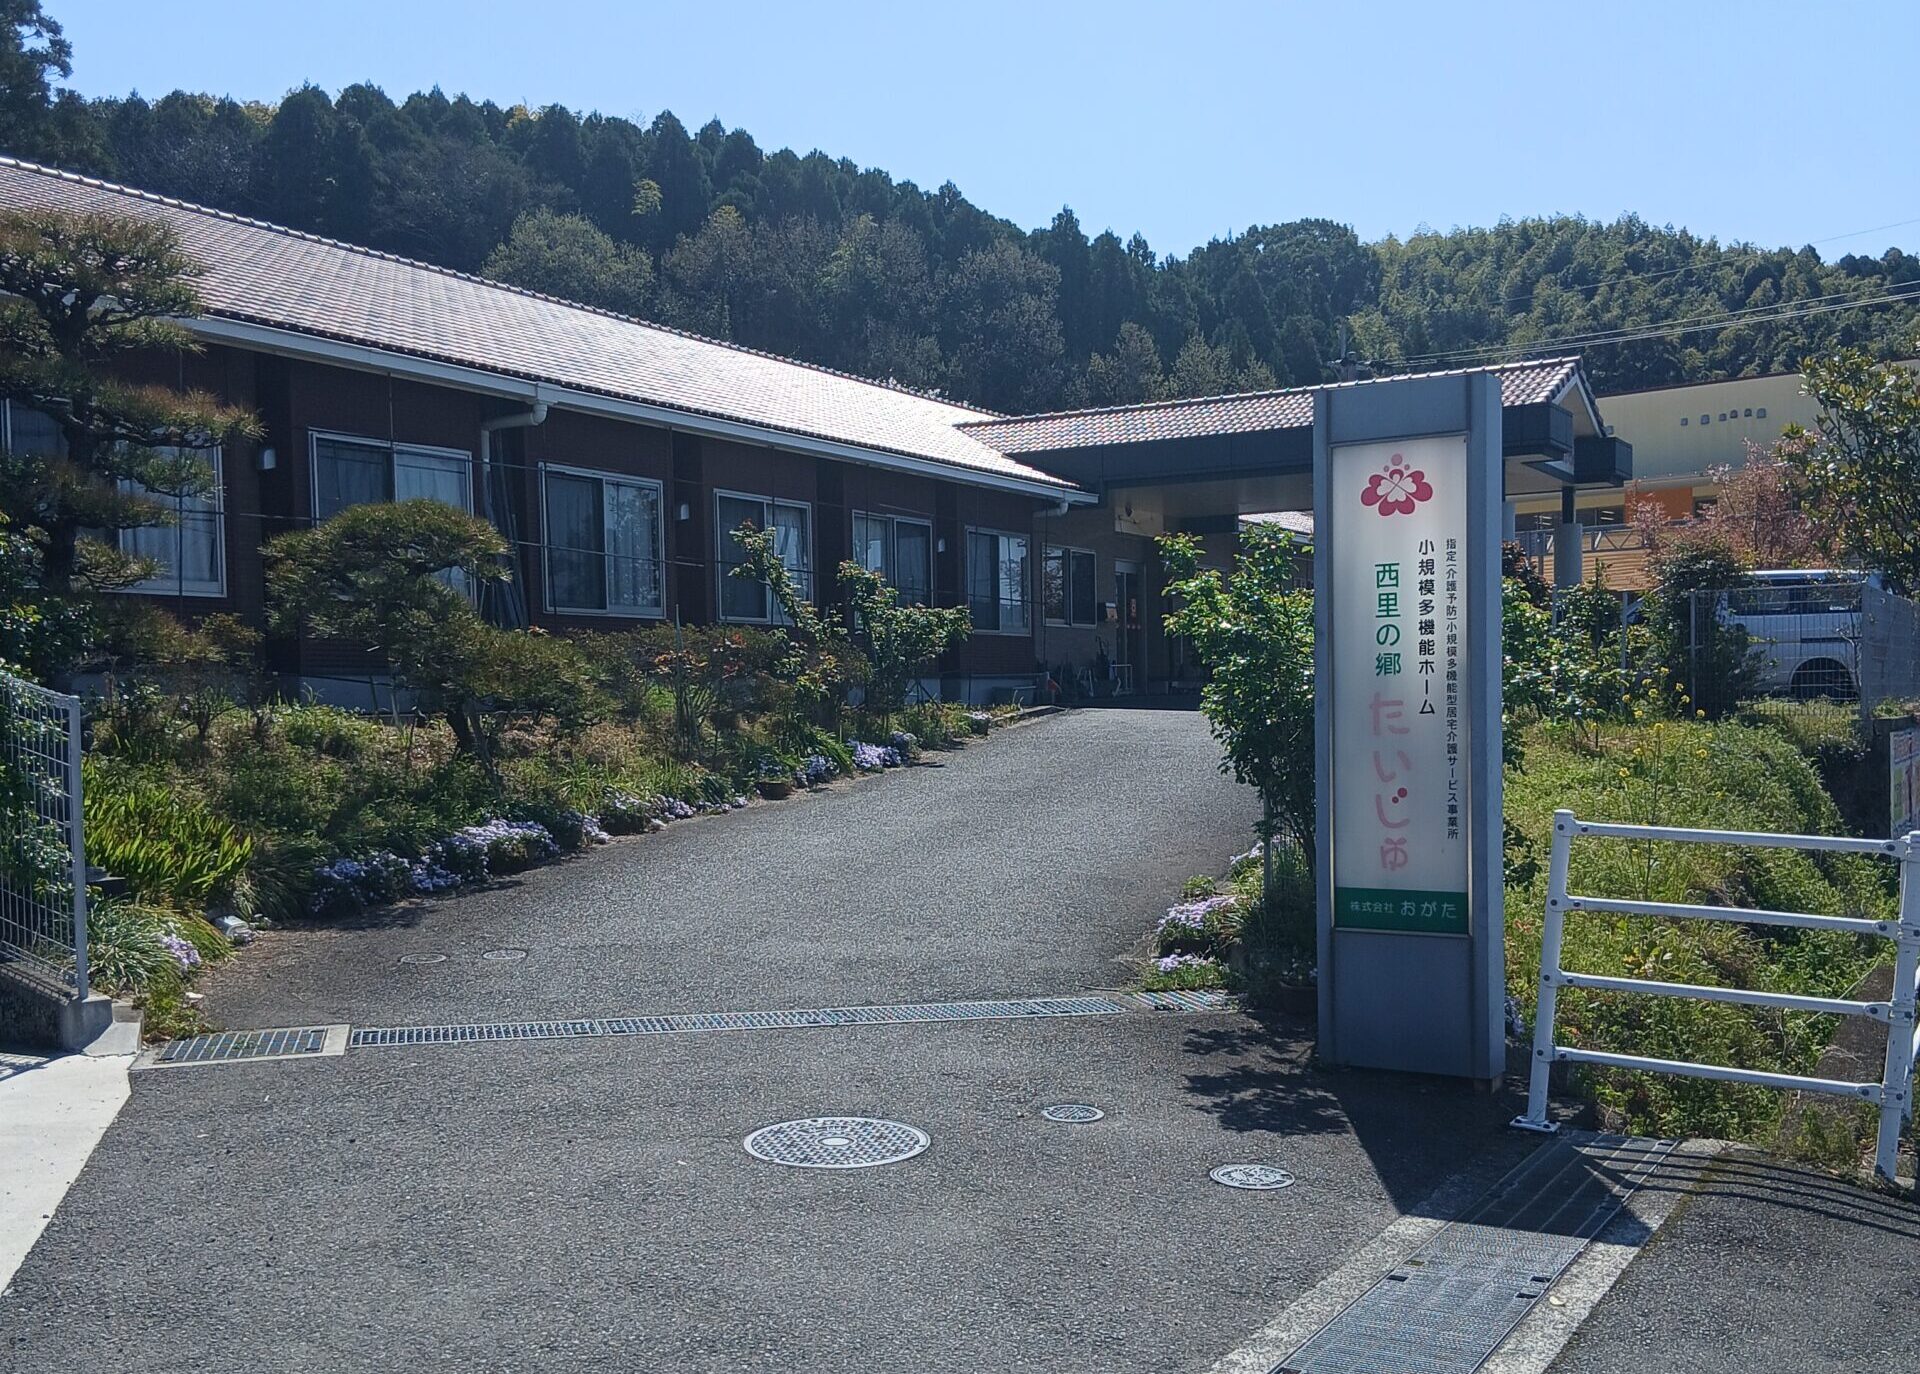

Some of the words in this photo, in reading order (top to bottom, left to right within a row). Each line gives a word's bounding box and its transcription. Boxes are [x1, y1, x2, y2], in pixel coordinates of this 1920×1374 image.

[1374, 562, 1402, 677] 西里の郷
[1418, 539, 1436, 716] 小規模多機能ホーム
[1369, 691, 1411, 872] たいじゅ
[1350, 901, 1394, 913] 株式会社
[1400, 901, 1457, 919] おがた
